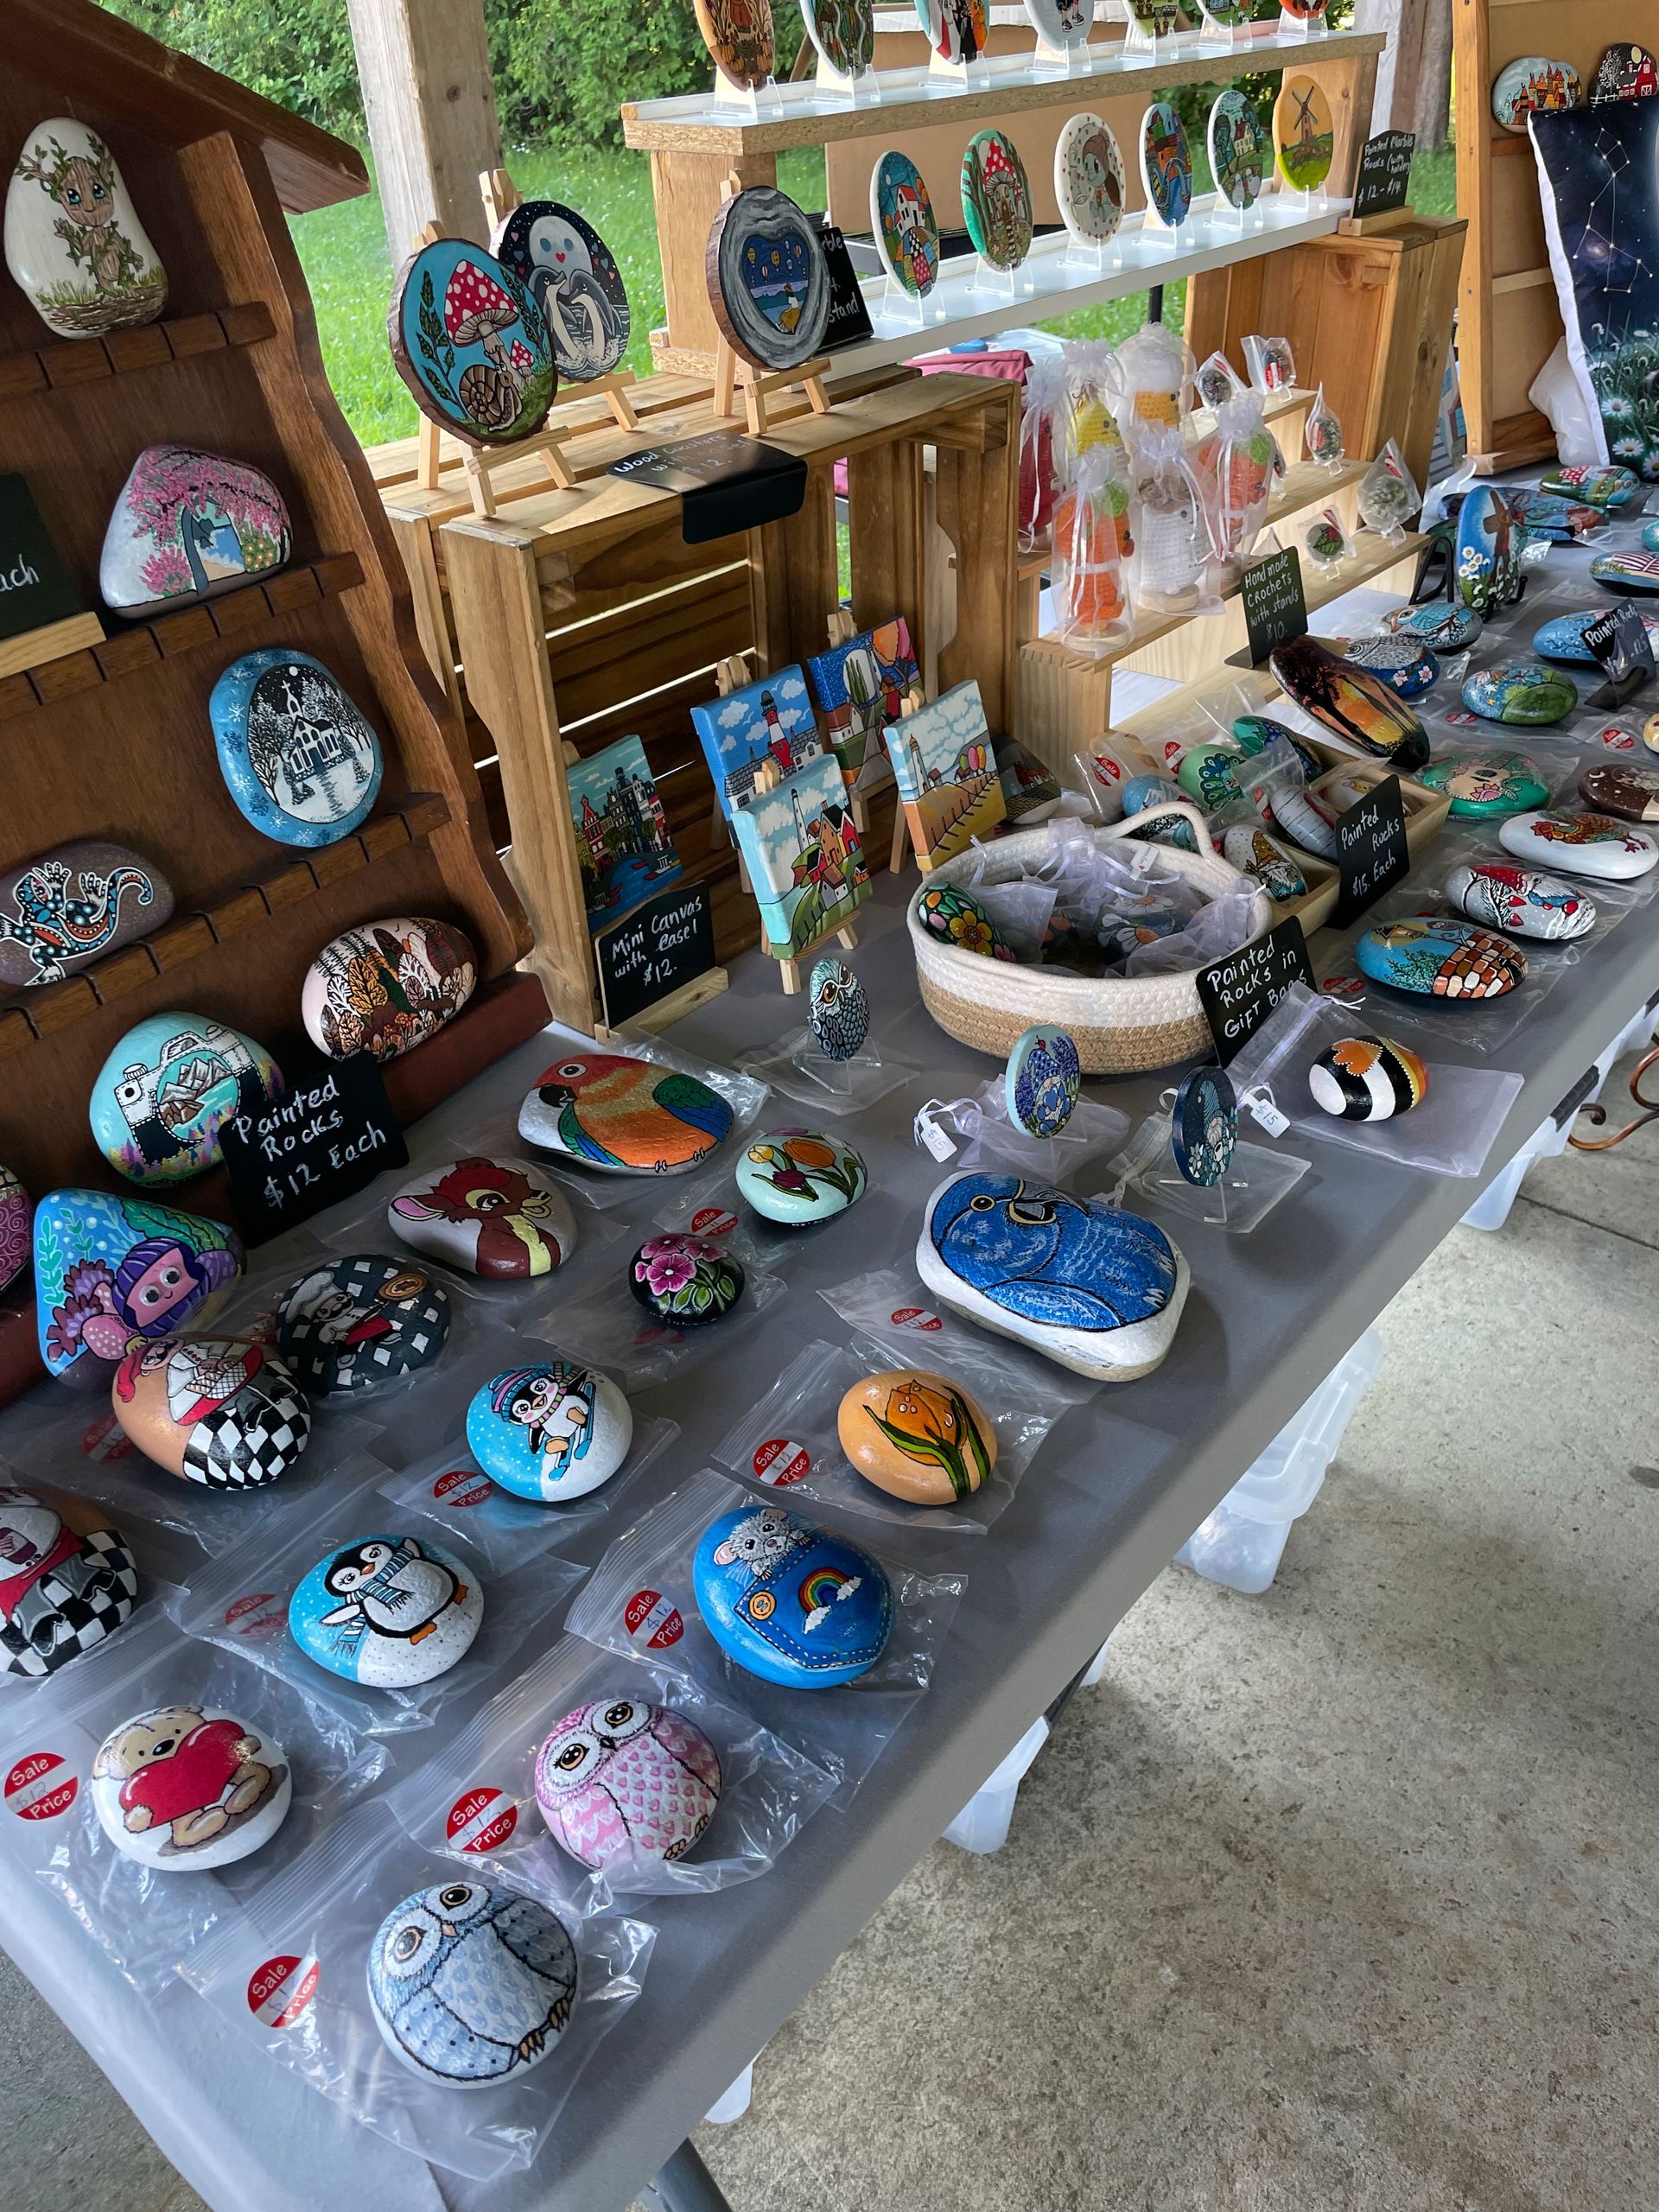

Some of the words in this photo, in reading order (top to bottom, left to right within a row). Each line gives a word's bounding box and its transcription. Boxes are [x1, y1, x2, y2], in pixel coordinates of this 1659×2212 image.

[1365, 137, 1389, 156] Painted
[1390, 134, 1414, 149] Marble
[1363, 157, 1384, 171] Rocks
[614, 451, 661, 473] Wood
[663, 433, 727, 454] Coasters
[652, 453, 693, 472] with
[0, 553, 41, 592] ach
[1250, 604, 1270, 628] with
[1274, 587, 1299, 613] stands
[1585, 613, 1621, 646] Painted
[1100, 760, 1117, 774] Sale
[1341, 804, 1379, 850] Painted
[1372, 818, 1400, 852] Rocks
[1374, 849, 1396, 881] Each
[612, 924, 644, 963] Mini
[651, 895, 702, 934] Canvas
[614, 950, 646, 978] with
[1207, 934, 1274, 993] Painted
[1282, 950, 1296, 969] in
[232, 1075, 340, 1144] Painted
[1255, 1104, 1279, 1126] $15
[260, 1109, 343, 1162] Rocks
[264, 1163, 321, 1209] $12
[327, 1121, 386, 1169] Each
[695, 1211, 716, 1227] Sale
[894, 1310, 916, 1322] Sale
[756, 1444, 779, 1466] Sale
[438, 1474, 466, 1491] Sale
[782, 1459, 807, 1483] Price
[458, 1489, 489, 1506] Price
[628, 1595, 653, 1623] Sale
[657, 1618, 682, 1645] Price
[12, 1758, 49, 1786] Sale
[29, 1789, 72, 1819] Price
[452, 1795, 488, 1826] Sale
[472, 1818, 512, 1851] Price
[251, 1964, 287, 1999] Sale
